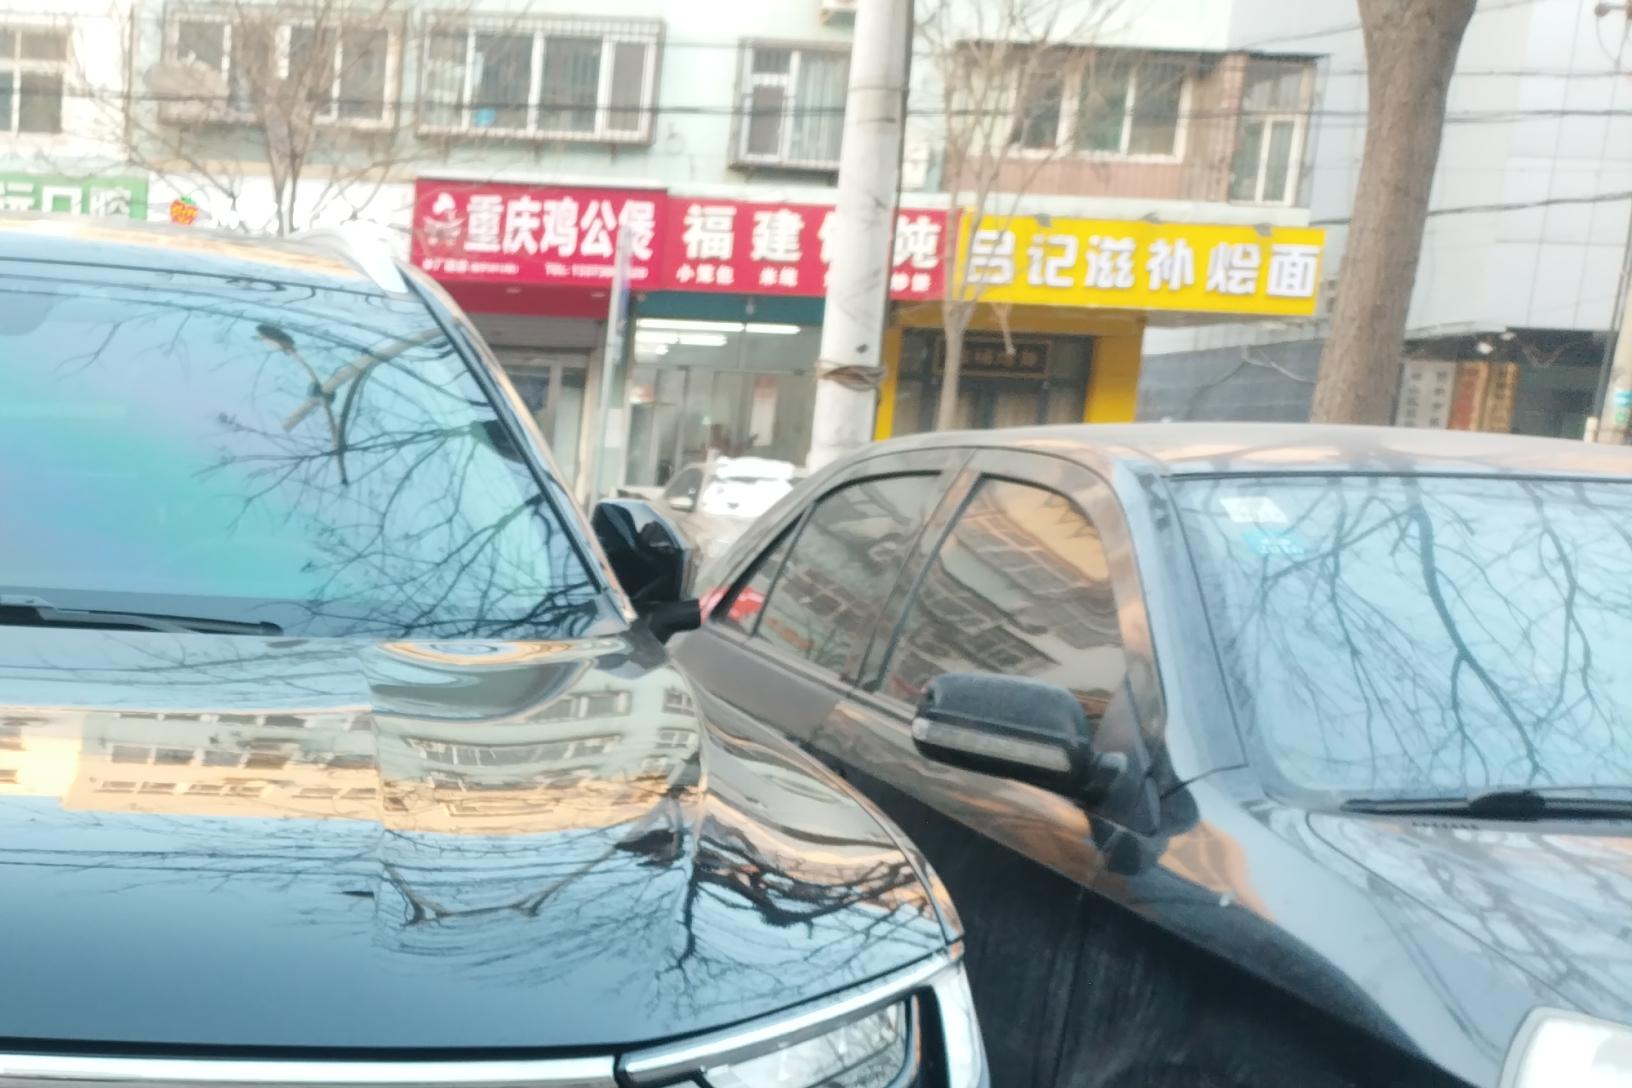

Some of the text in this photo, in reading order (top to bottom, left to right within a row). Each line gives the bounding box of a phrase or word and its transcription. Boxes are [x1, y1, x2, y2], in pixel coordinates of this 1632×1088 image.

[464, 194, 656, 261] 重庆鸡公煲
[681, 203, 943, 270] 福建饨
